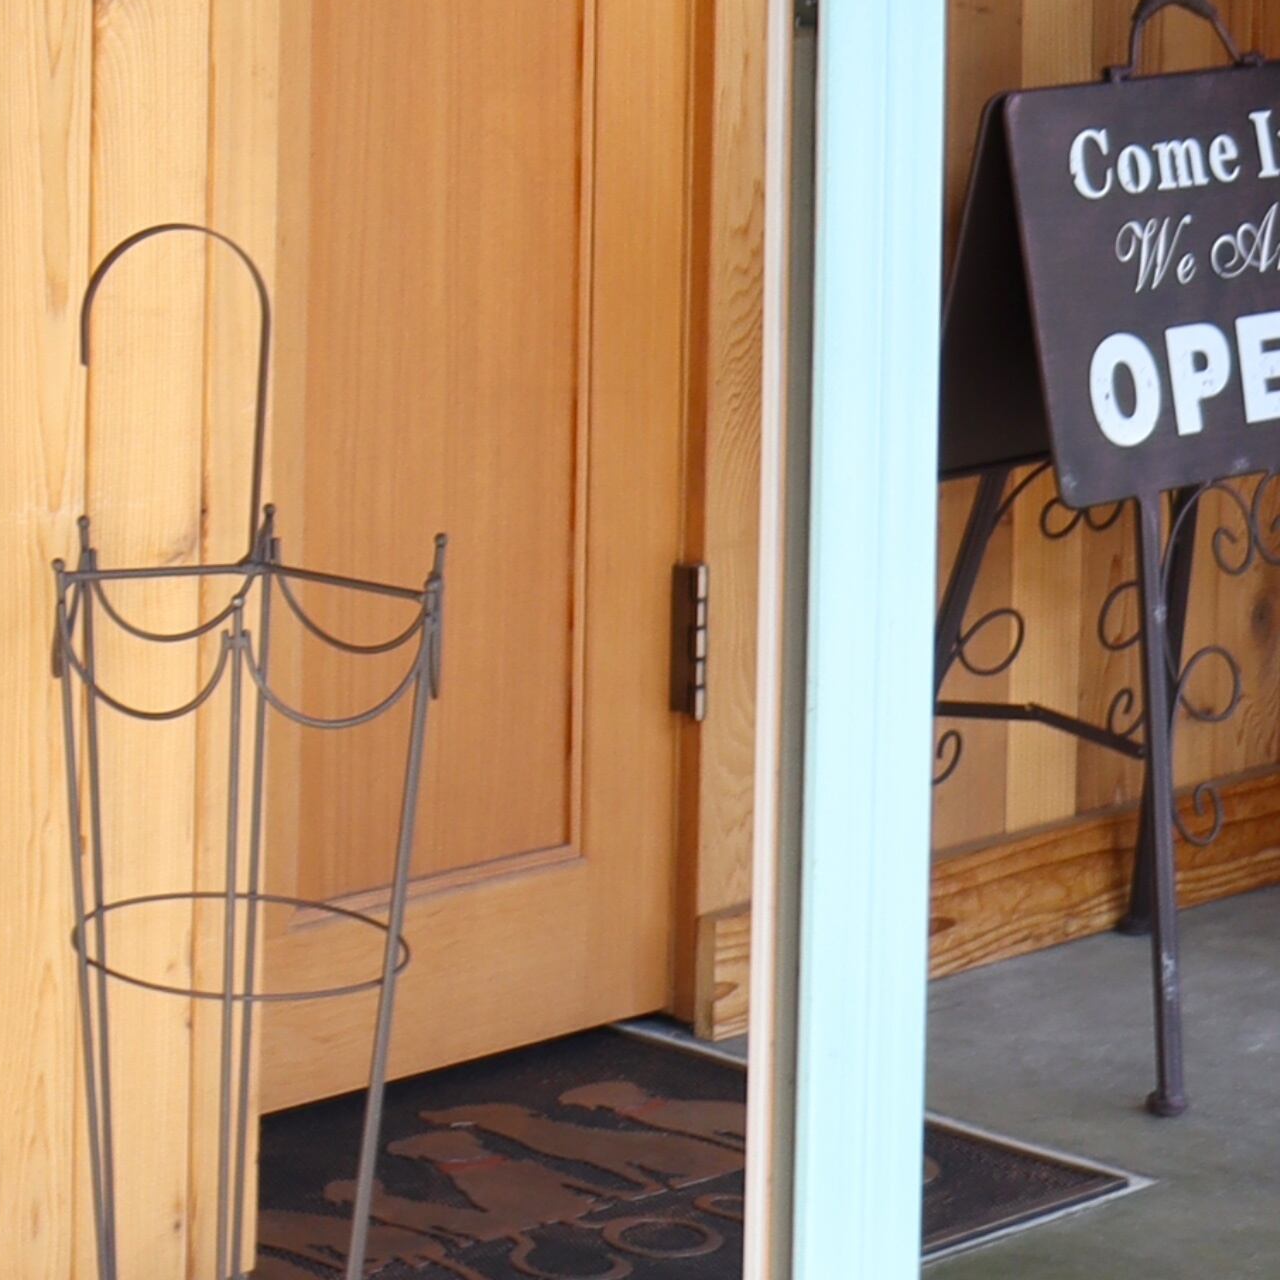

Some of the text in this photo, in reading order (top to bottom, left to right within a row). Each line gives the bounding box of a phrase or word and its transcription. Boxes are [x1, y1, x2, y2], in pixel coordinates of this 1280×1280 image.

[1069, 110, 1280, 199] Come I
[1115, 202, 1280, 293] We A
[1089, 312, 1280, 447] OPE
